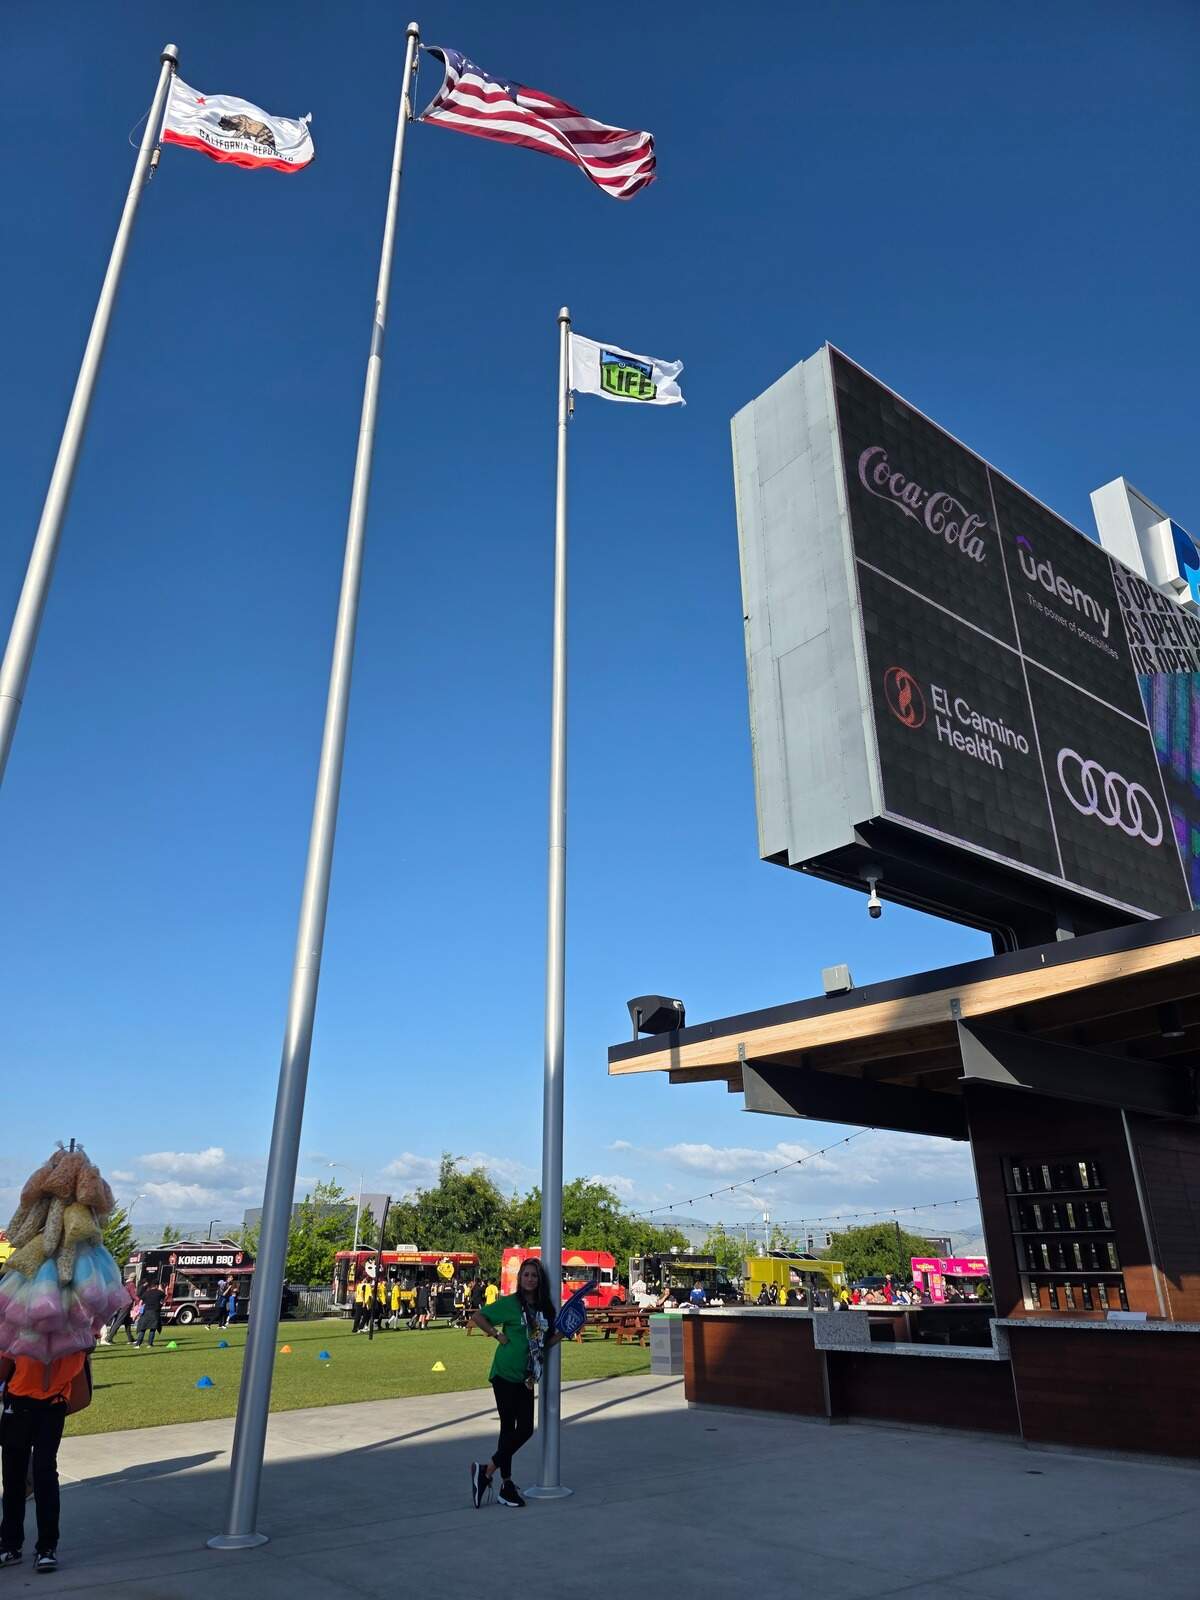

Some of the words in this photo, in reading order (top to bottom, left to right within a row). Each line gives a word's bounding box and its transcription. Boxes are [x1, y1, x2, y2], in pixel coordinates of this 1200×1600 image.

[199, 129, 249, 151] CALIFORNIA
[252, 144, 294, 162] REPUBC
[858, 446, 987, 562] Coca-Cola
[1043, 606, 1068, 628] power
[1141, 611, 1189, 647] OPEN
[930, 684, 953, 718] El
[955, 698, 1029, 754] Camino
[935, 715, 1004, 770] Health
[178, 1255, 214, 1265] KOREAN
[215, 1255, 234, 1267] BBQ
